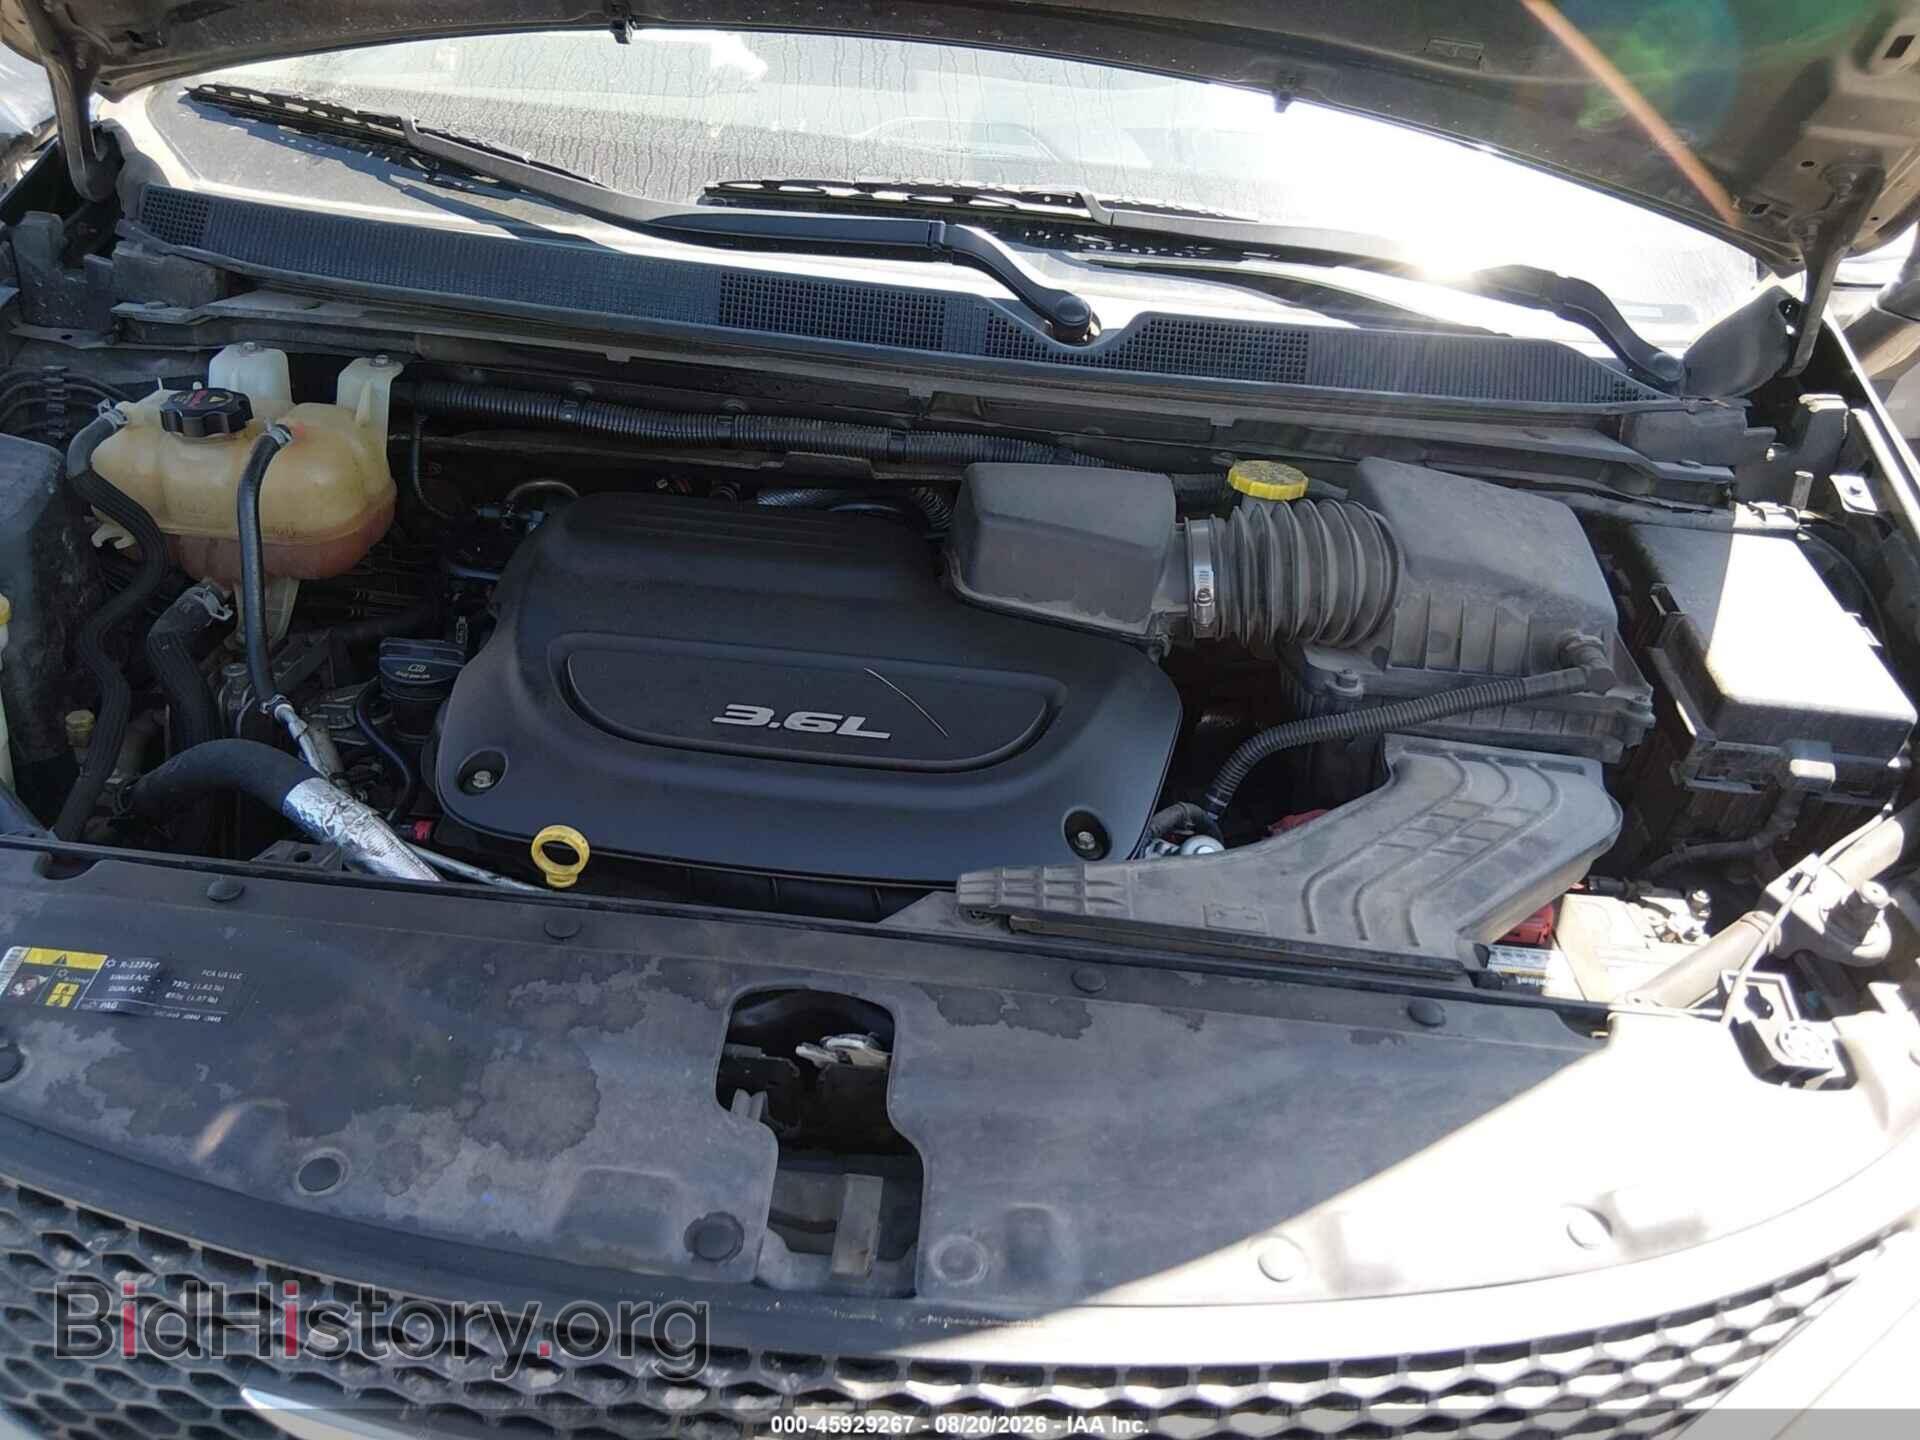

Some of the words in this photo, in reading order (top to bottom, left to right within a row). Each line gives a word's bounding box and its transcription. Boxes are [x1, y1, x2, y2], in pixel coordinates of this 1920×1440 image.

[712, 703, 891, 740] 3.6L
[120, 960, 160, 970] R-1234yf
[99, 1001, 119, 1010] PAG
